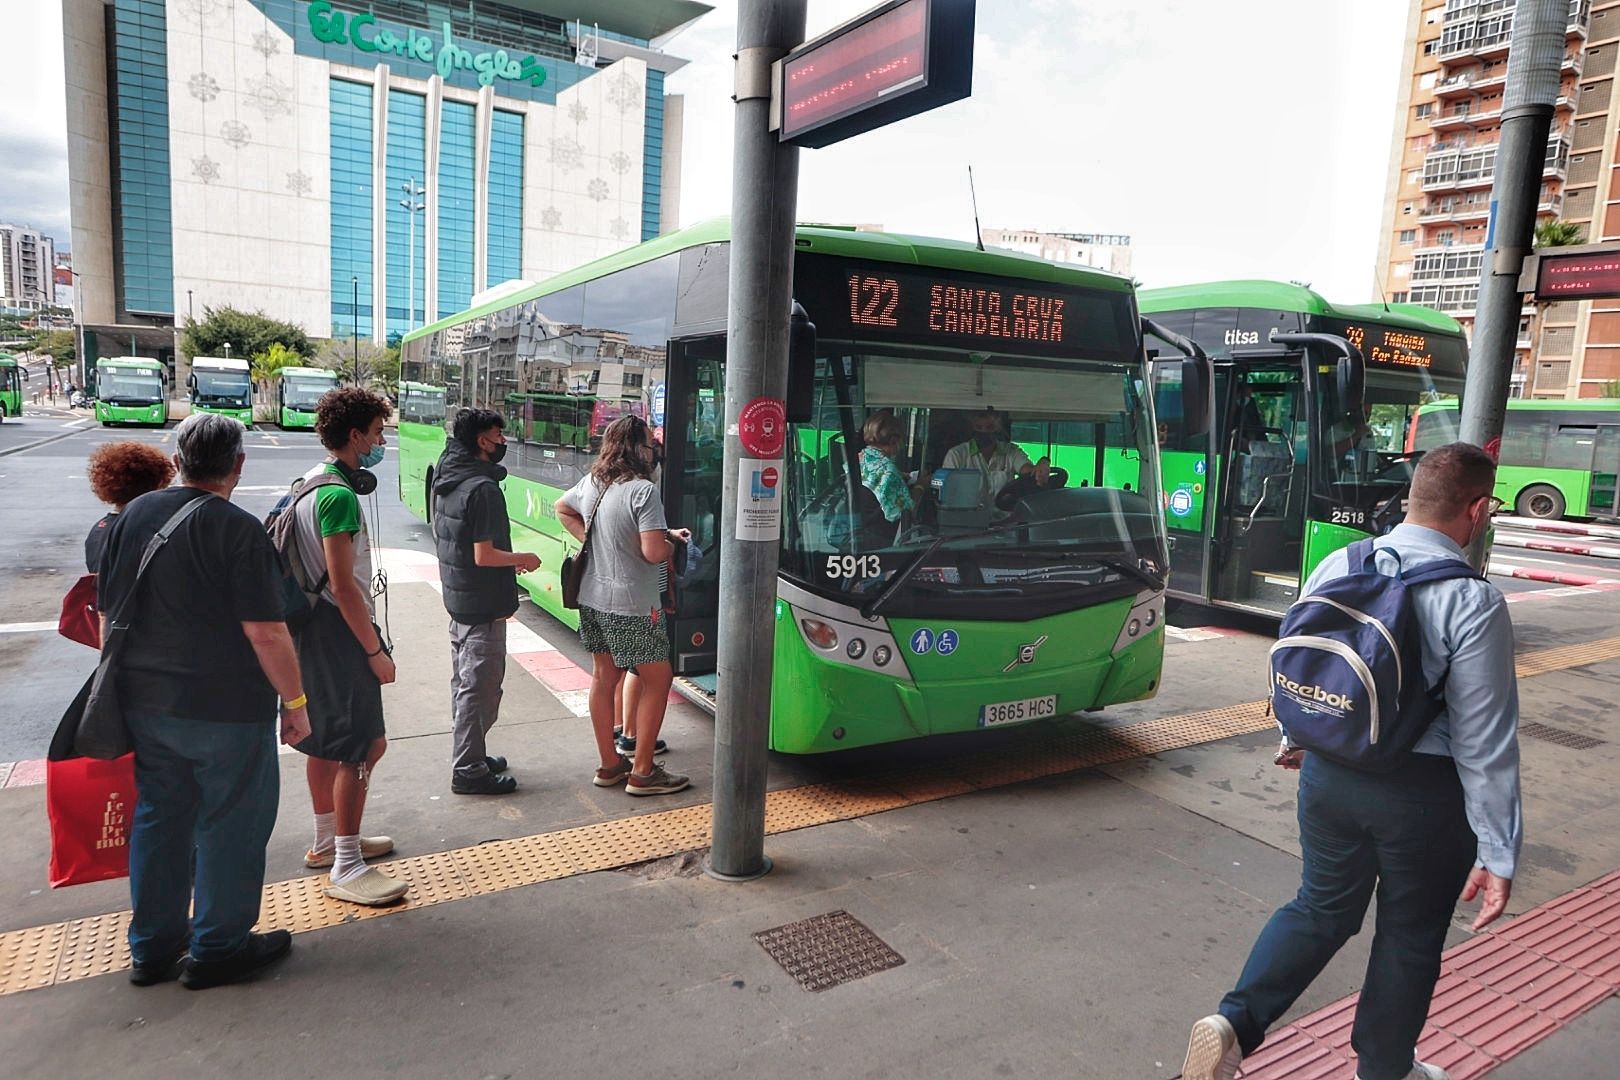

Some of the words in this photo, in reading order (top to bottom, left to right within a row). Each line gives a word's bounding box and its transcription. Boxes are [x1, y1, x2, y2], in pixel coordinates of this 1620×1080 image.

[308, 1, 348, 45] El
[351, 13, 434, 62] Corte
[848, 275, 899, 327] 122
[930, 284, 1000, 314] SANTA
[1012, 294, 1065, 321] CRUZ
[928, 308, 1063, 342] CANDELARIA
[1224, 329, 1259, 345] titsa
[1331, 510, 1365, 524] 2518
[825, 554, 881, 579] 5913
[1275, 671, 1355, 711] Reebok
[988, 702, 1024, 723] 3665
[1028, 698, 1054, 718] HCS
